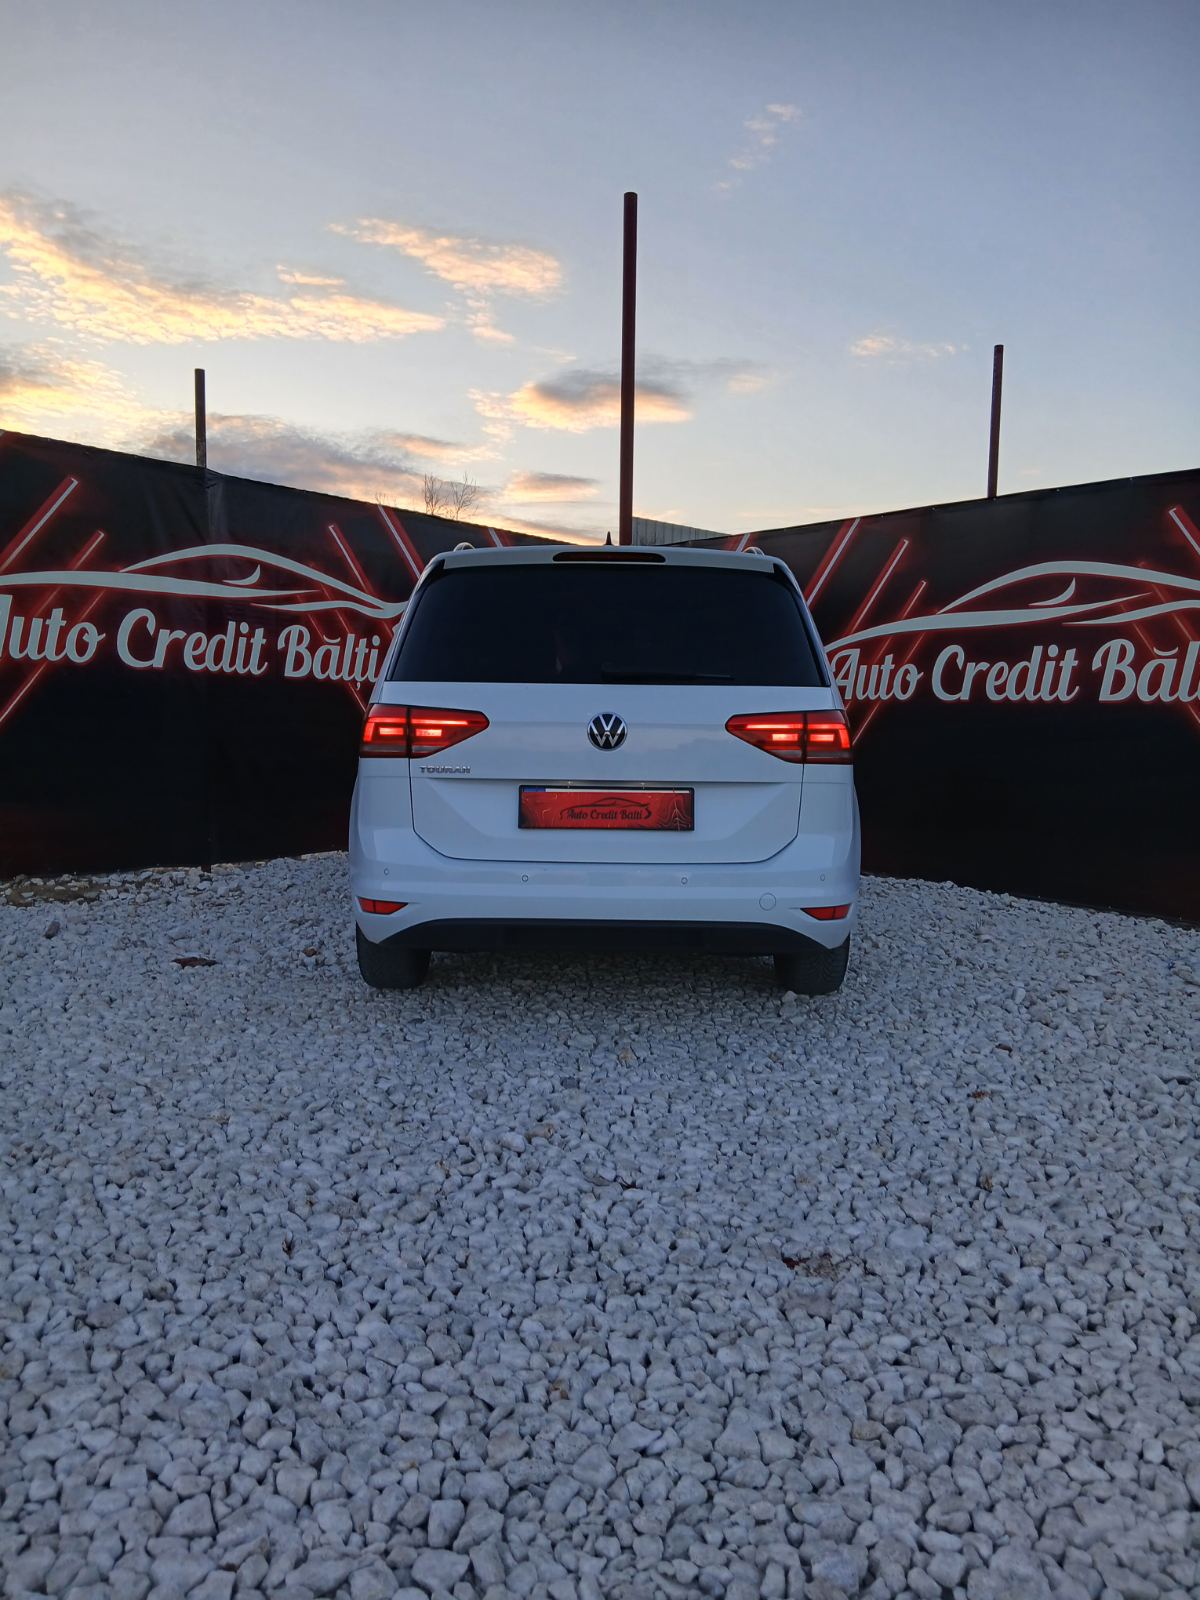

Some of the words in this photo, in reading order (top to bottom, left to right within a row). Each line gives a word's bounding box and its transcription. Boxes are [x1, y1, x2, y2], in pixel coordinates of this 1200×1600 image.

[116, 608, 268, 676] Credit
[277, 624, 381, 690] Bălți
[828, 648, 924, 701] Auto
[931, 645, 1080, 702] Credit
[1091, 638, 1200, 702] Băl
[419, 765, 472, 774] TOURAN
[568, 808, 588, 820] Auto
[590, 808, 618, 820] Credit
